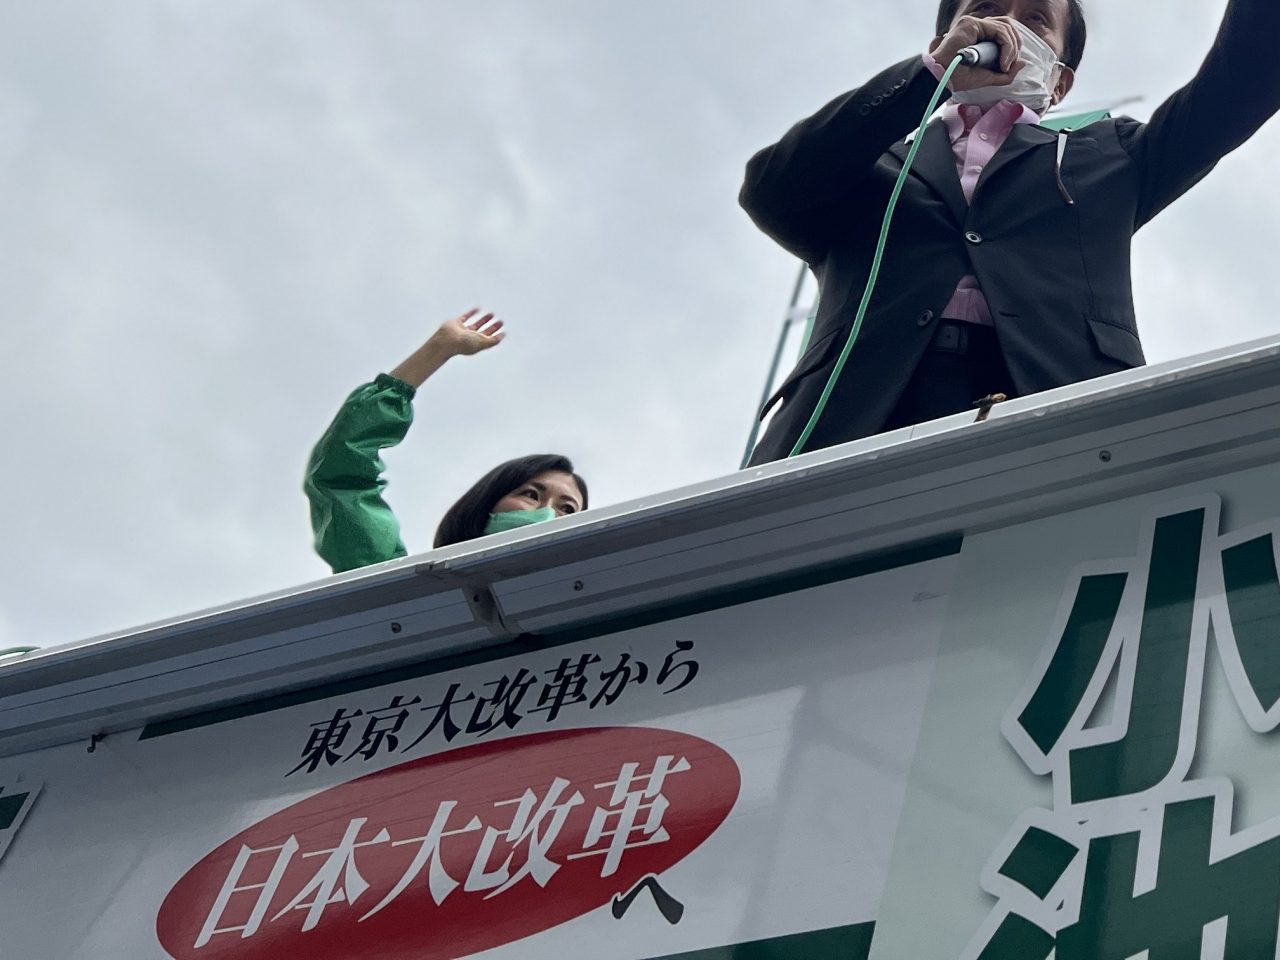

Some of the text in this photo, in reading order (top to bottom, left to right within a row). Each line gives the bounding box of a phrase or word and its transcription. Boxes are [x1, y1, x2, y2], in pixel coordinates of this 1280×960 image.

[284, 639, 701, 778] 東京大改革から
